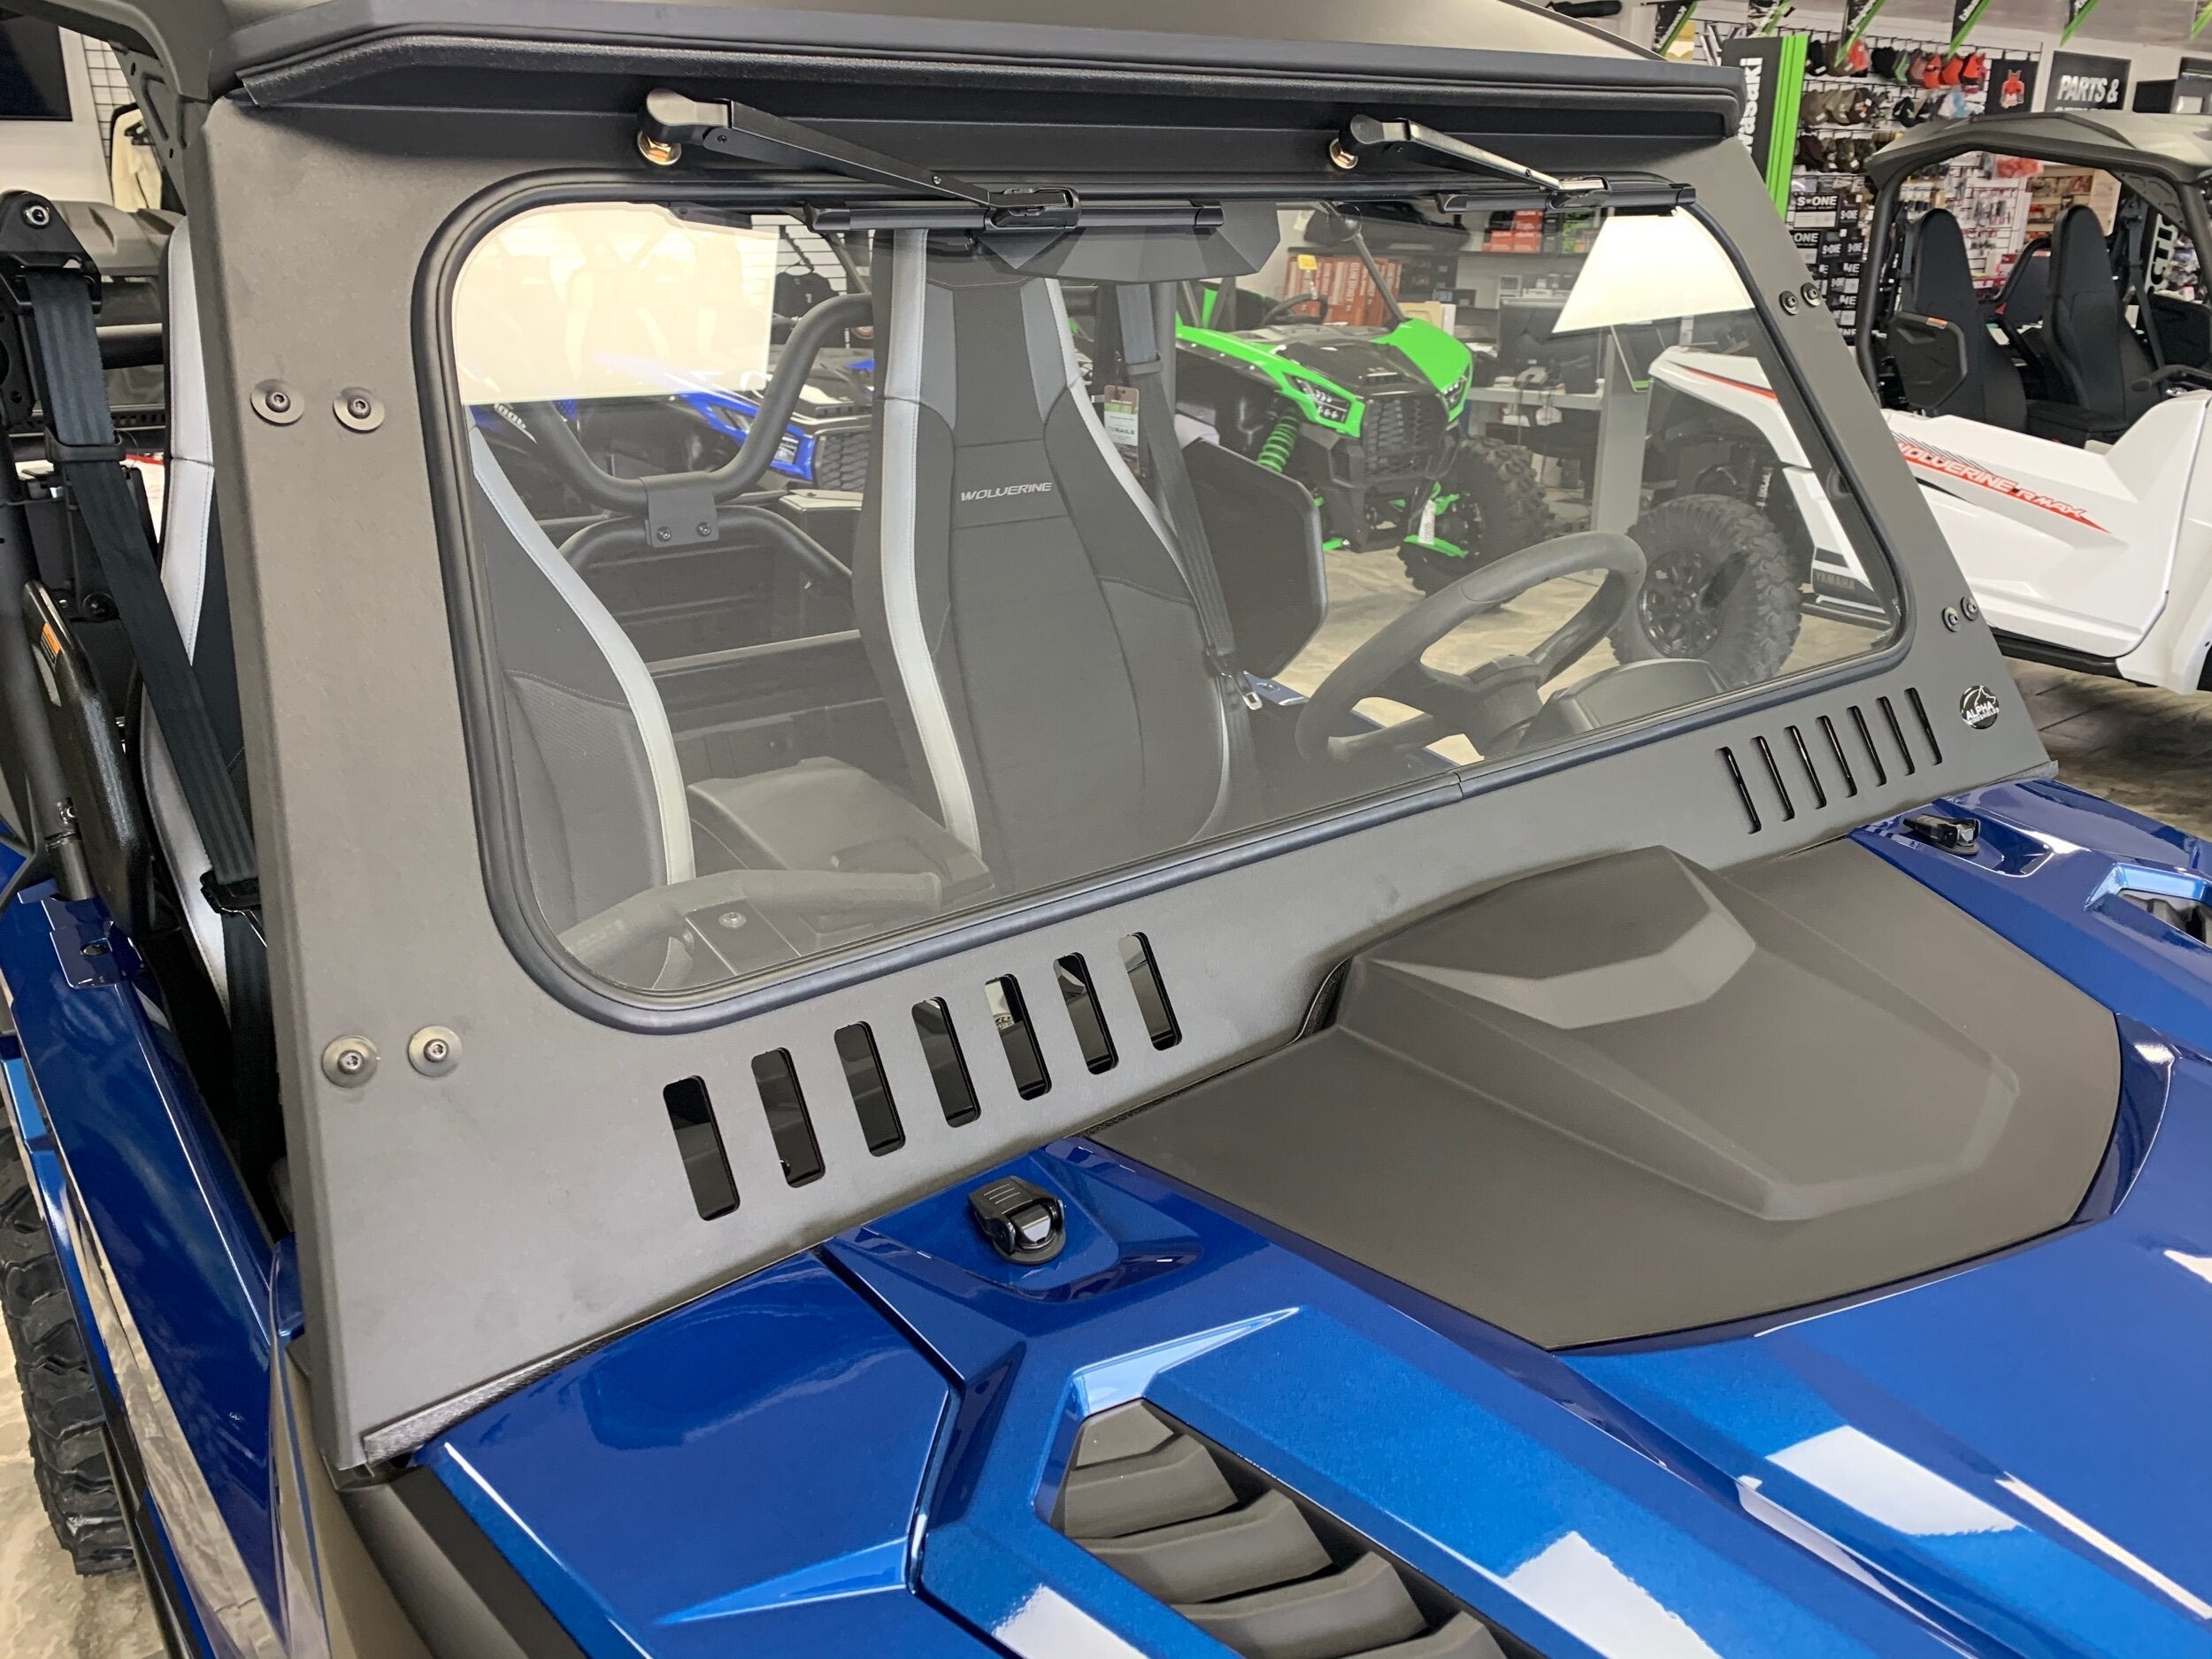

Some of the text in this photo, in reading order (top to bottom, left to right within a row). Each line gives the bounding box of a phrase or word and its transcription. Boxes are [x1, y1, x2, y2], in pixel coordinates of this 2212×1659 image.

[2057, 74, 2120, 104] PARTS &
[1738, 58, 1763, 155] wasaki
[961, 482, 1053, 502] WOLVERINE
[1966, 701, 1996, 720] ALPHA
